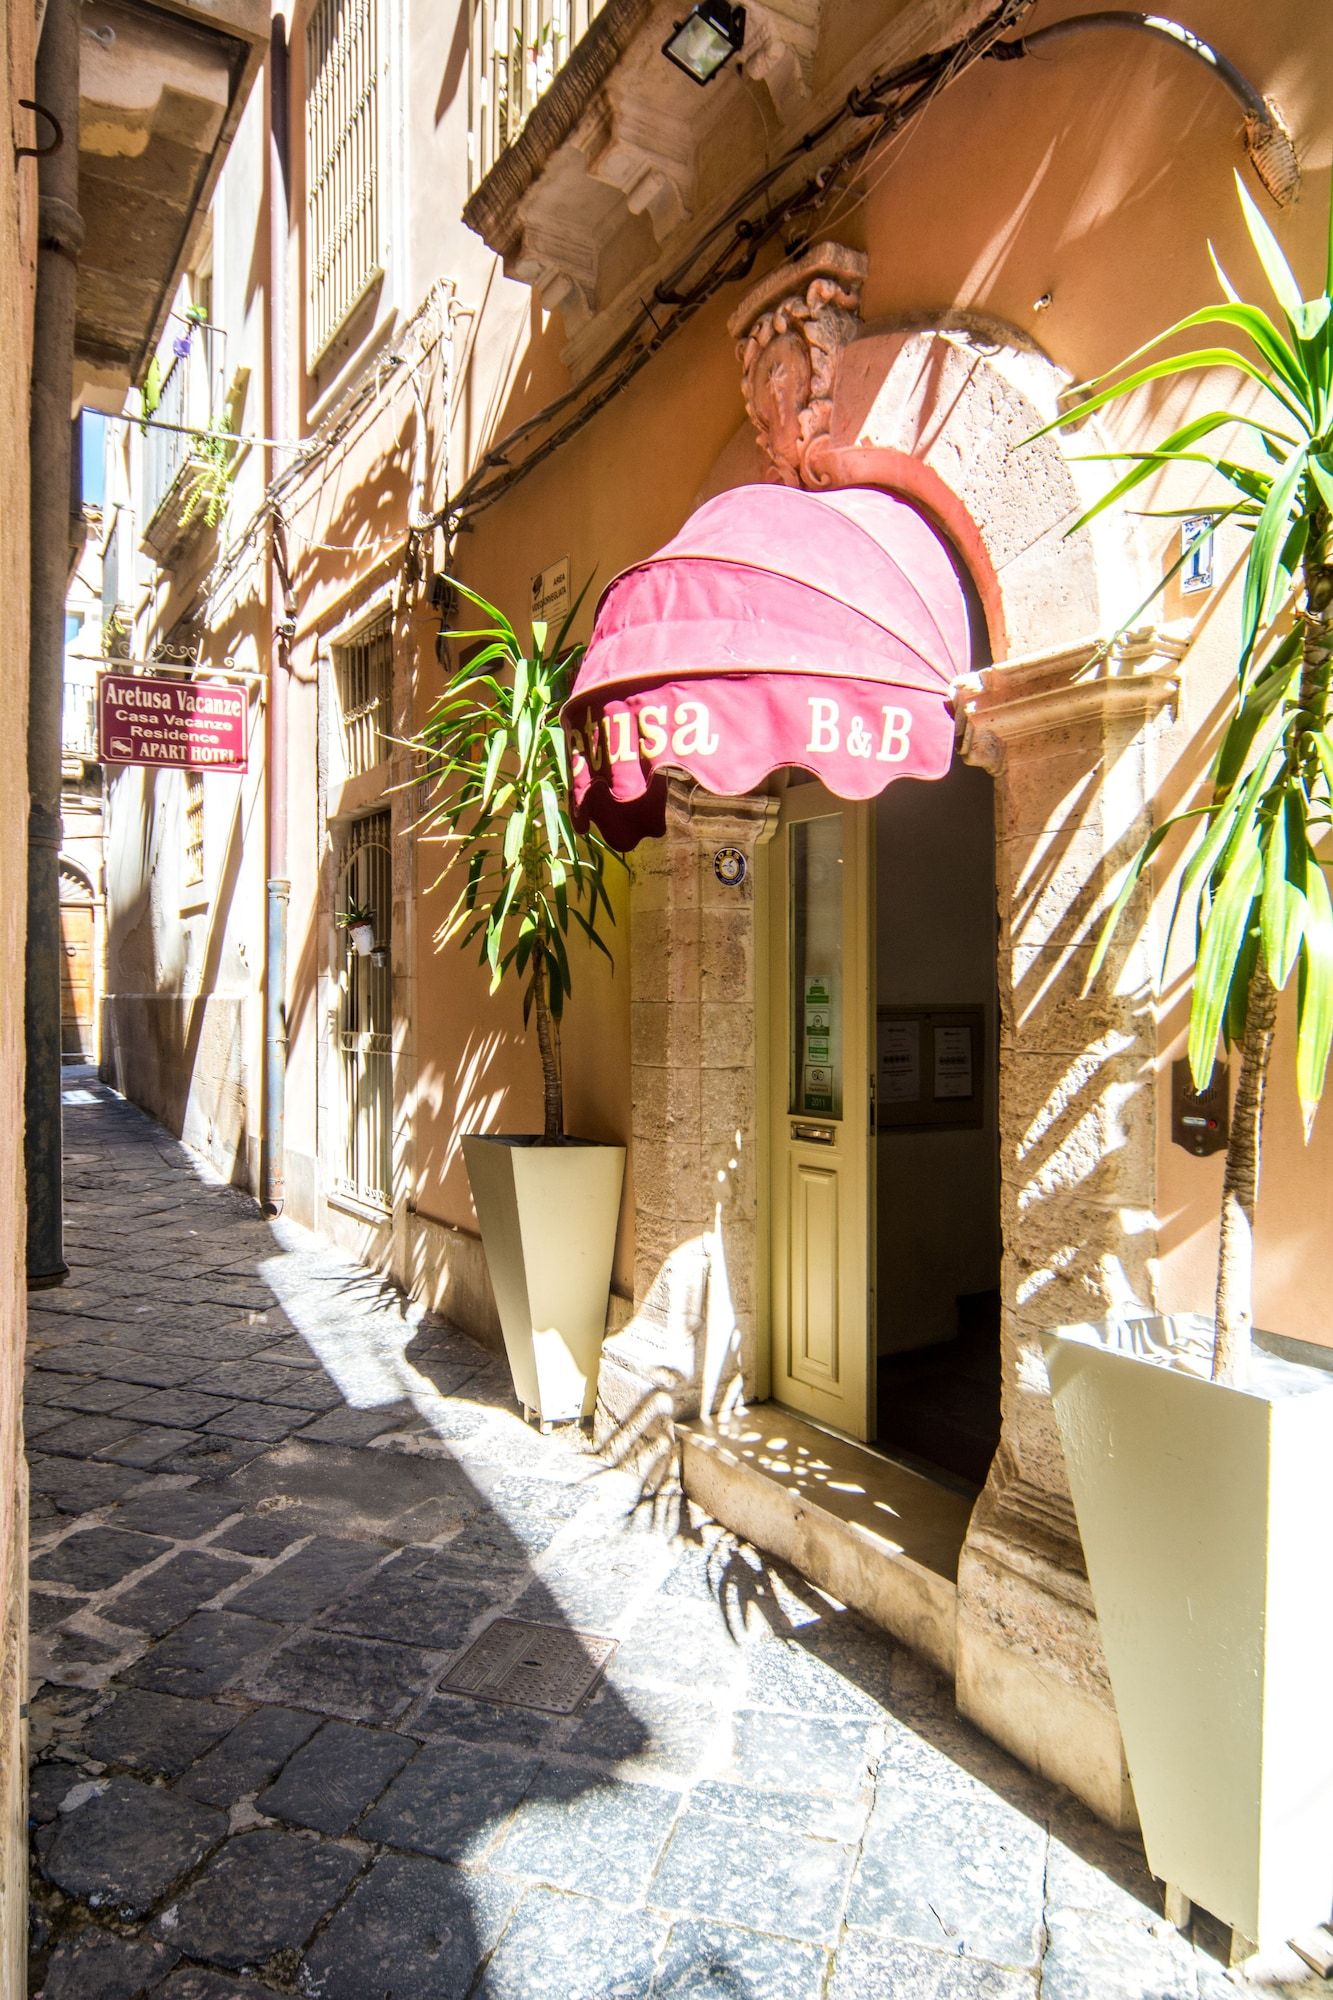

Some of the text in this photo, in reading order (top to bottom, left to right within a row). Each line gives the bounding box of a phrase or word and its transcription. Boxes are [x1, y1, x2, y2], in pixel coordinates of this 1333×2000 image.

[105, 683, 241, 717] Aretusa Vacanze
[115, 709, 233, 731] Casa Vacanze
[130, 725, 219, 744] Residence
[139, 742, 234, 763] APART HOTEL
